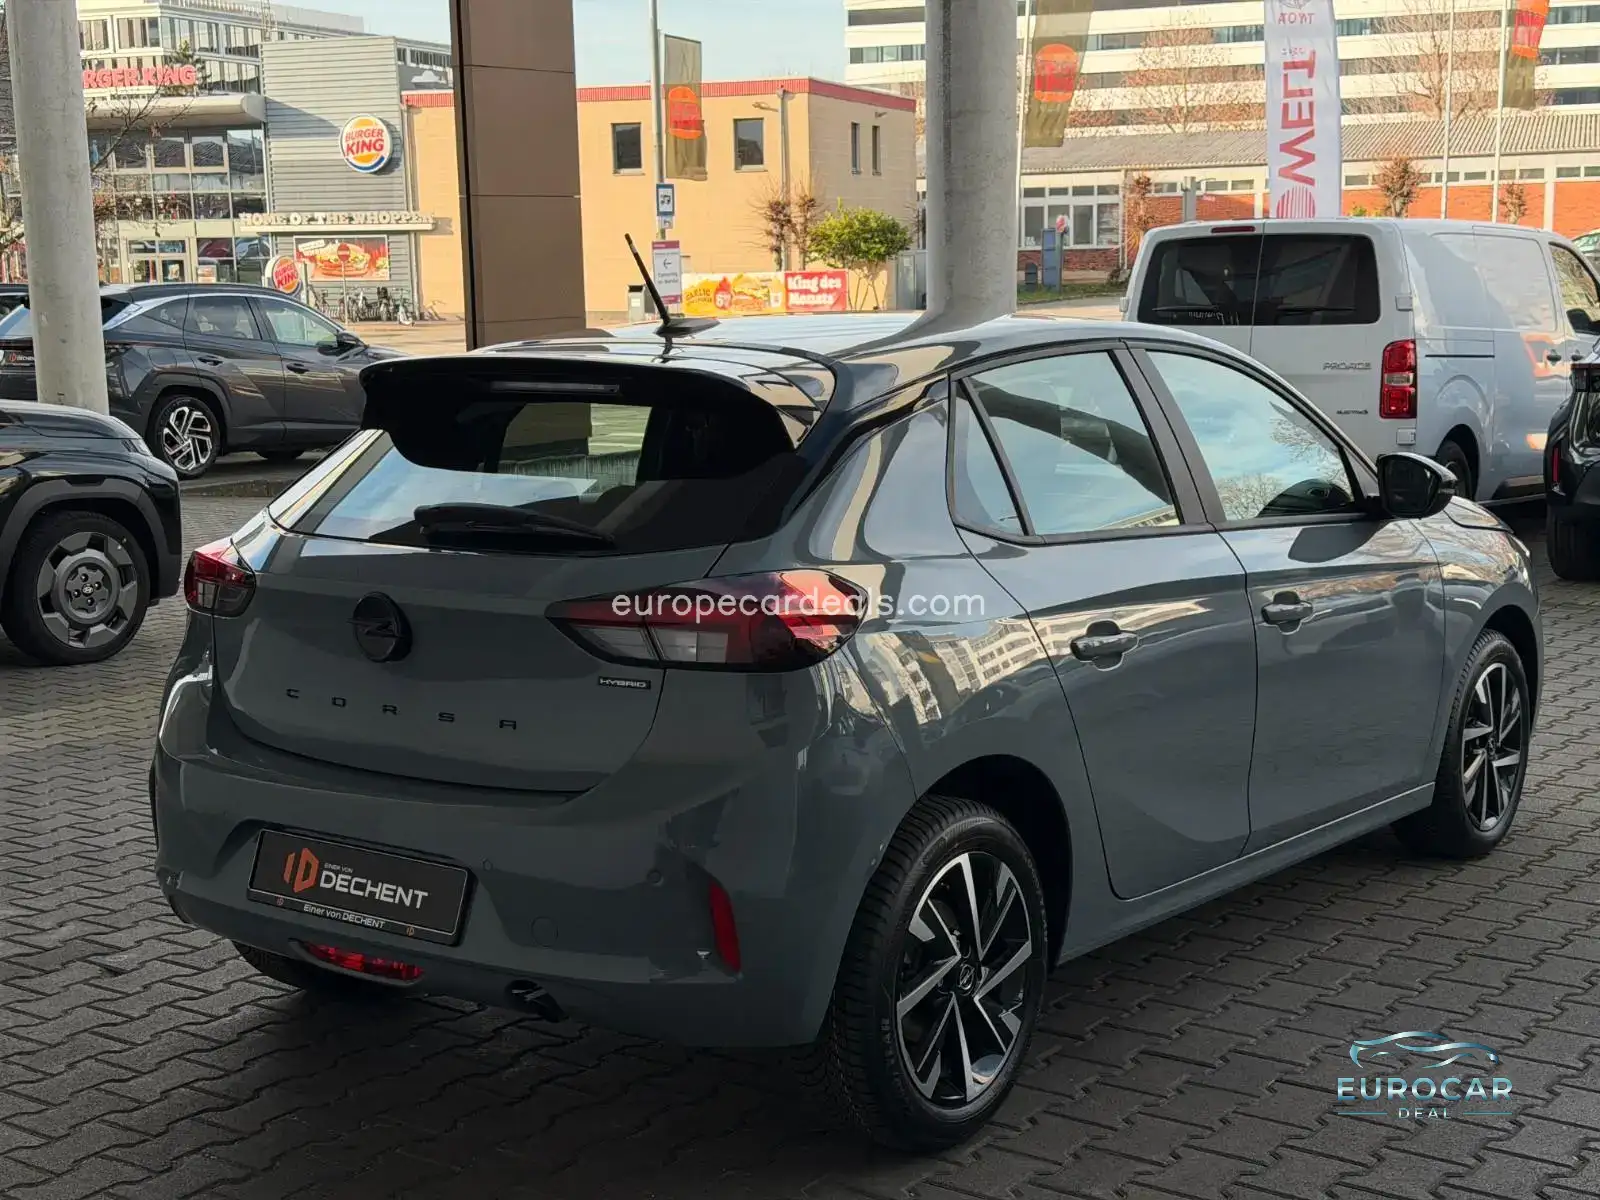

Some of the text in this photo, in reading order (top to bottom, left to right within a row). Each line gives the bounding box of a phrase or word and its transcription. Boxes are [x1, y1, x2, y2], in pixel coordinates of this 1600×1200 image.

[83, 64, 197, 88] RGER KING
[345, 128, 384, 141] BURGER
[346, 138, 384, 156] KING
[238, 211, 287, 226] HOME
[314, 211, 348, 225] THE
[352, 211, 434, 224] WHOPPER
[788, 275, 819, 293] King
[820, 274, 842, 289] des
[600, 678, 646, 688] HYBRID
[286, 688, 517, 730] CORSA
[320, 870, 429, 909] DECHENT
[303, 904, 386, 929] Einer von DECHENT
